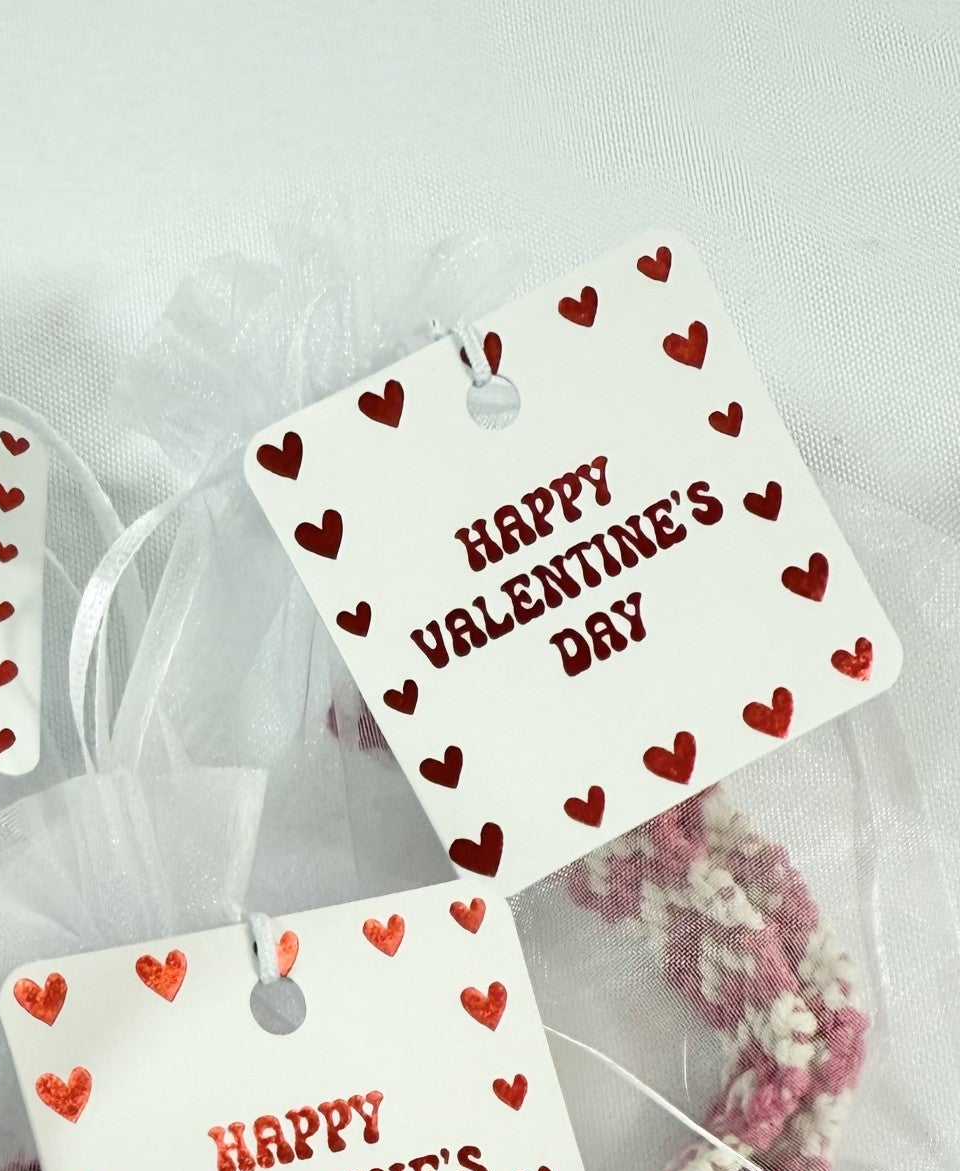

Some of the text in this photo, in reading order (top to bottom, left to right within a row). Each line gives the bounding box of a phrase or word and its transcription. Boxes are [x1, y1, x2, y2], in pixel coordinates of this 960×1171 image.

[454, 455, 612, 572] HAPPY
[410, 480, 724, 669] VALENTINE'S
[549, 591, 647, 677] DAY
